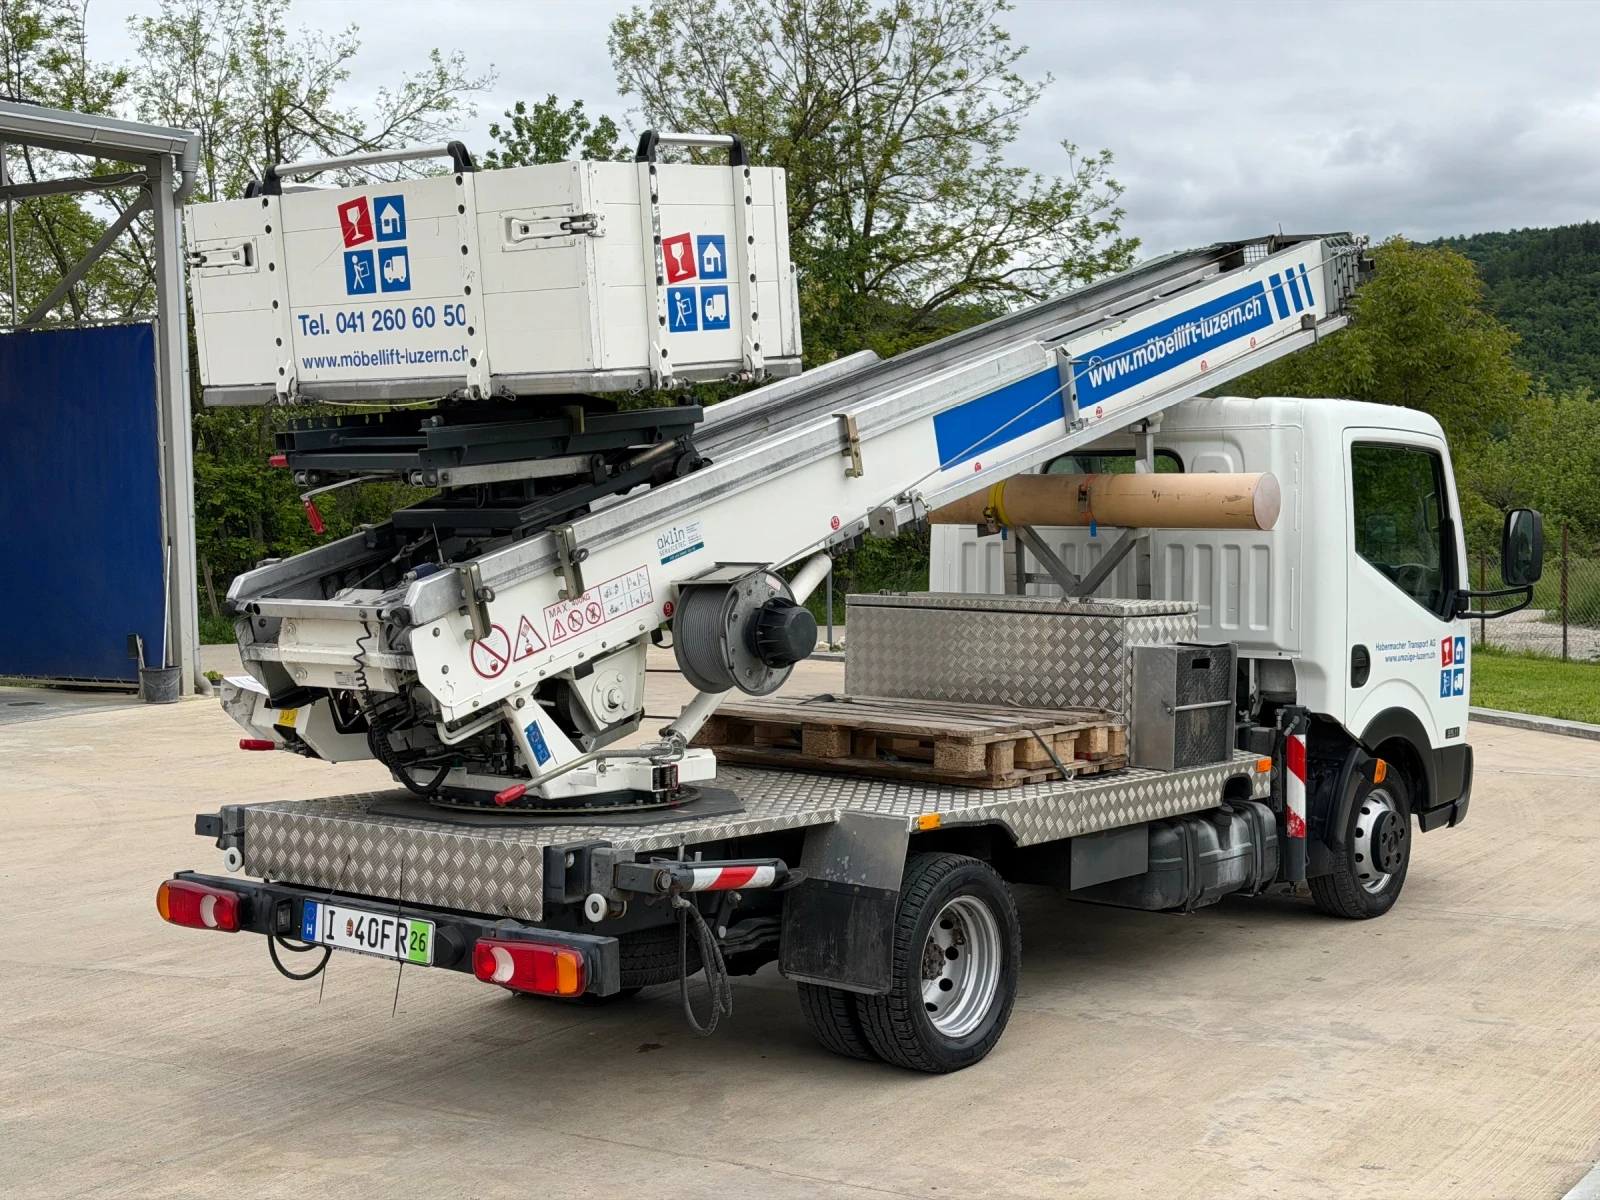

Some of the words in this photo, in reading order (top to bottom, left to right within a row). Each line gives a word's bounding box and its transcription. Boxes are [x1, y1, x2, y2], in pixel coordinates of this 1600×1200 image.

[298, 313, 330, 336] Tel.
[336, 311, 365, 333] 041
[372, 308, 406, 331] 260
[412, 306, 436, 328] 60
[443, 303, 466, 326] 50
[1088, 297, 1262, 388] www.möbellift-luzern.ch
[302, 345, 468, 369] www.möbellift-luzern.ch
[656, 526, 685, 550] aklin
[548, 604, 570, 619] MAX.
[1408, 640, 1429, 649] Transport
[1430, 639, 1436, 648] AG
[306, 924, 313, 935] H
[410, 931, 426, 952] 26
